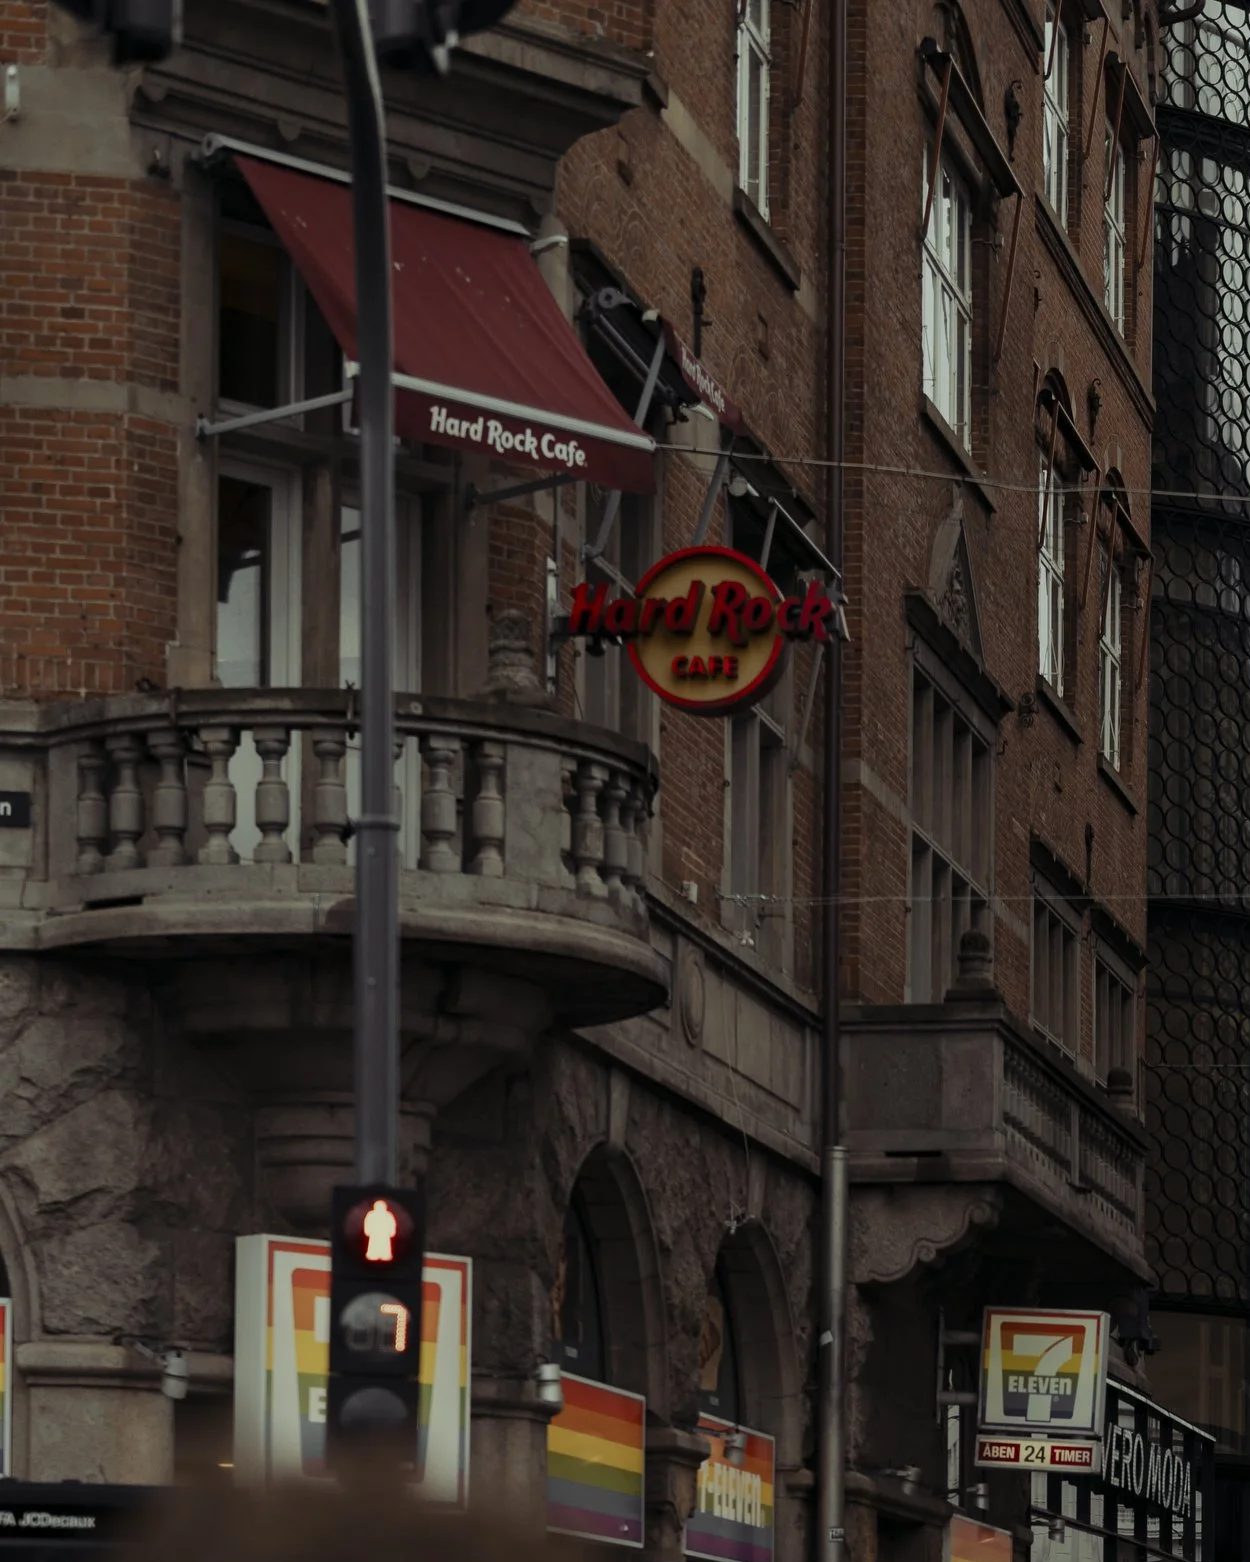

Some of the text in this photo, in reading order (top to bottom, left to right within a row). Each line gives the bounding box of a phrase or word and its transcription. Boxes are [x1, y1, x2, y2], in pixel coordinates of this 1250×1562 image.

[430, 405, 586, 468] Hard Rock Cafe
[568, 580, 834, 647] Hard Rock
[671, 656, 738, 680] CAFE
[380, 1303, 407, 1352] 7
[983, 1442, 1091, 1463] ÅBEN 24 TIMER
[1101, 1422, 1191, 1518] VERO MODA
